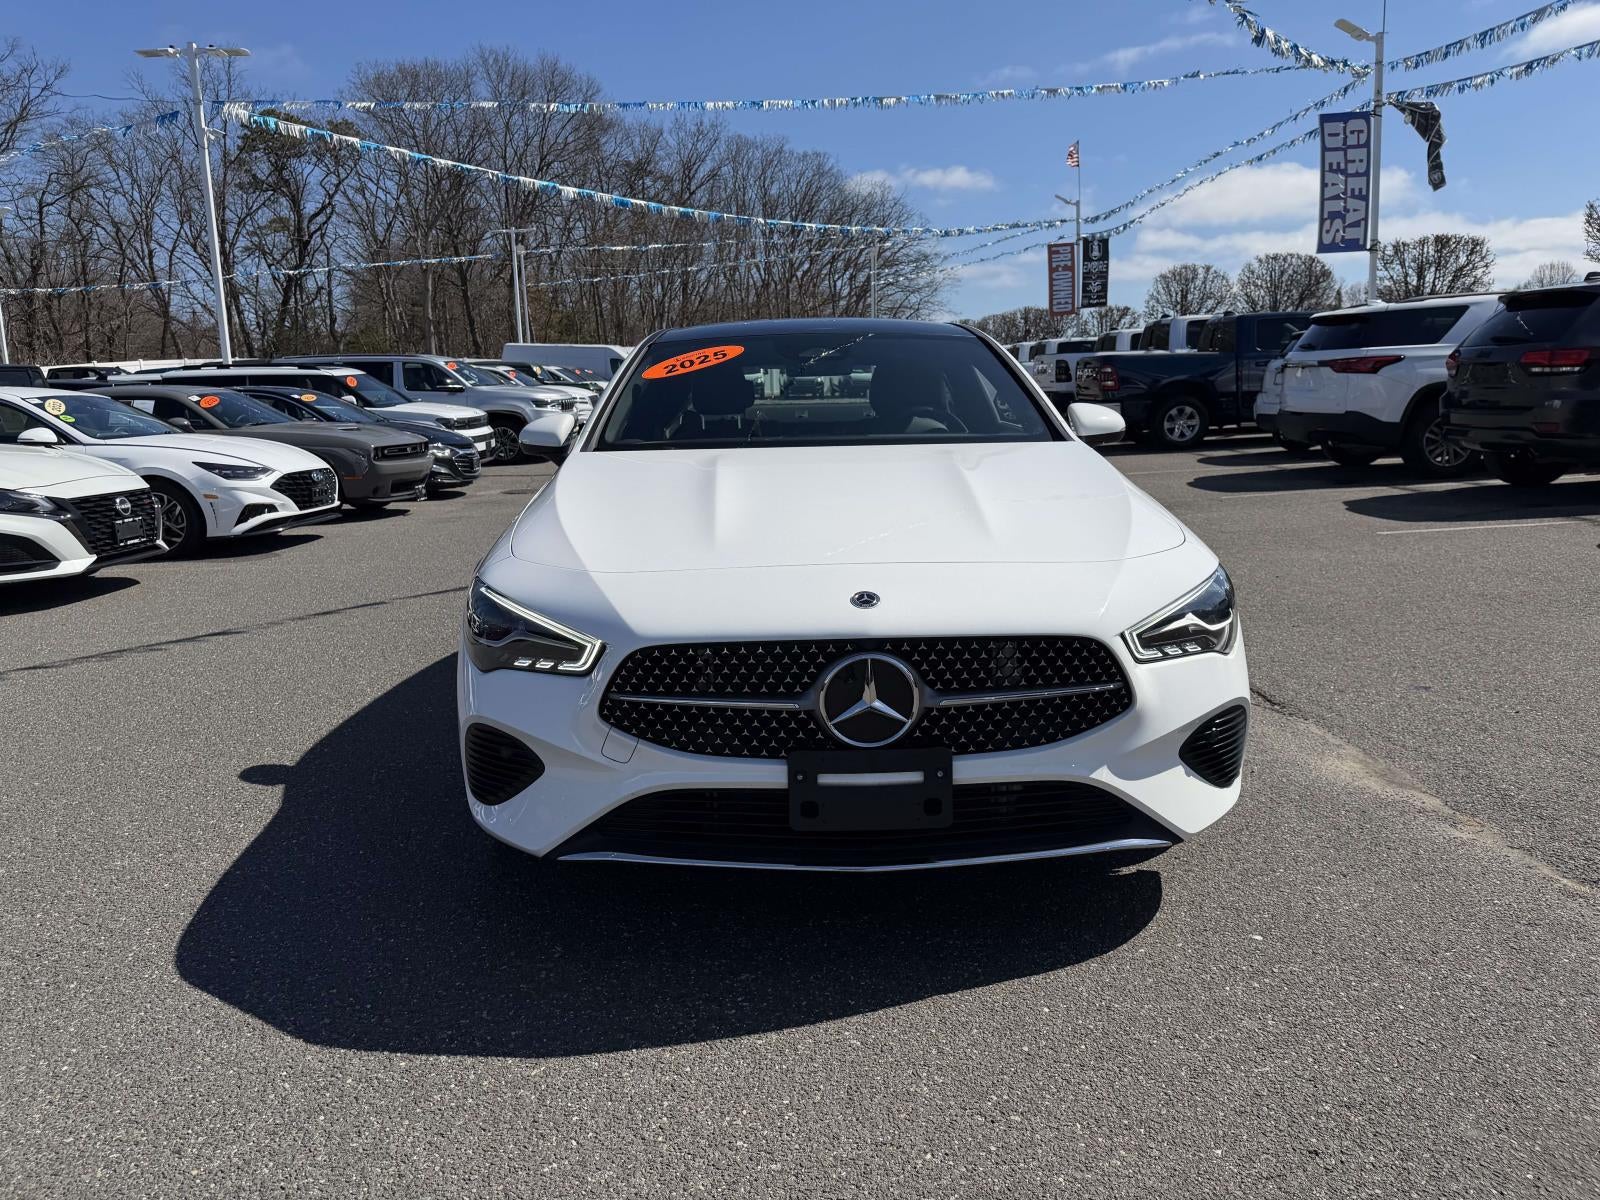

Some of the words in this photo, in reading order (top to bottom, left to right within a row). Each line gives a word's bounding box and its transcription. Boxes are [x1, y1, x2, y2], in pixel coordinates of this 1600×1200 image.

[1321, 121, 1345, 245] DEALS
[1345, 118, 1368, 245] GREAT
[1051, 245, 1073, 313] PRE-OWNED
[663, 350, 728, 375] 2025
